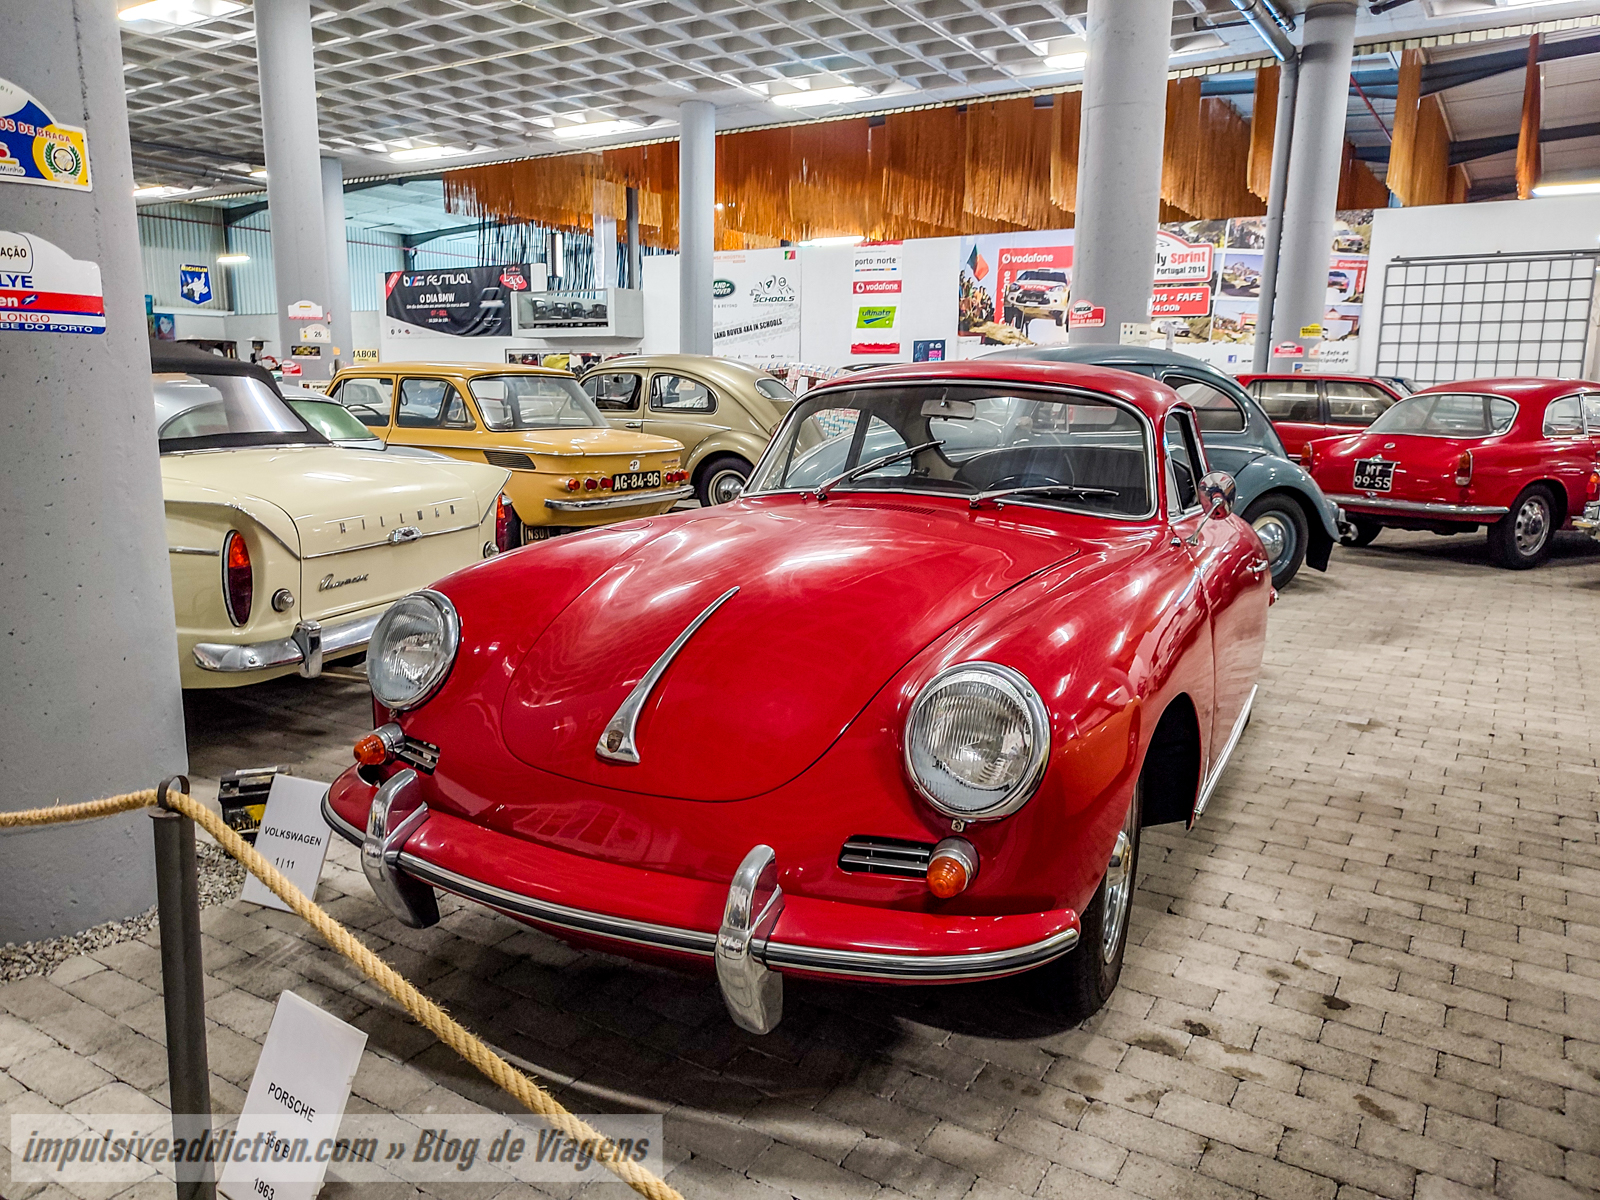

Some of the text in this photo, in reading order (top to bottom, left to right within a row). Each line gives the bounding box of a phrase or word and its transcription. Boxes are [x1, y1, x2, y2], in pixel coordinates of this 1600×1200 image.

[18, 121, 35, 136] DE
[36, 127, 71, 142] BRAGA
[0, 245, 27, 260] AÇÃO
[1011, 252, 1054, 263] vodafone
[1170, 251, 1206, 265] Sprint
[855, 256, 896, 267] porto norte
[1156, 265, 1205, 276] Portugal 2014
[0, 274, 34, 289] LYE
[866, 282, 898, 291] vodafone
[420, 292, 455, 303] O DIA BMW
[754, 294, 795, 303] SCHOOLS
[1176, 292, 1203, 302] FAFE
[0, 312, 50, 324] LONGO
[862, 308, 891, 317] ultimate
[24, 323, 46, 331] DO
[50, 324, 93, 333] PORTO
[714, 330, 726, 339] LAND
[726, 327, 742, 337] ROVER
[753, 323, 759, 331] IN
[759, 318, 783, 330] SCHOOLS
[632, 461, 637, 469] P
[1365, 464, 1383, 476] MT
[614, 472, 660, 491] AG-84-96
[1355, 475, 1391, 488] 99-55
[339, 505, 455, 534] HILLMAN
[528, 529, 545, 540] NSU
[264, 826, 321, 846] VOLKSWAGEN
[267, 1082, 316, 1123] PORSCHE
[253, 1177, 275, 1200] 1963
